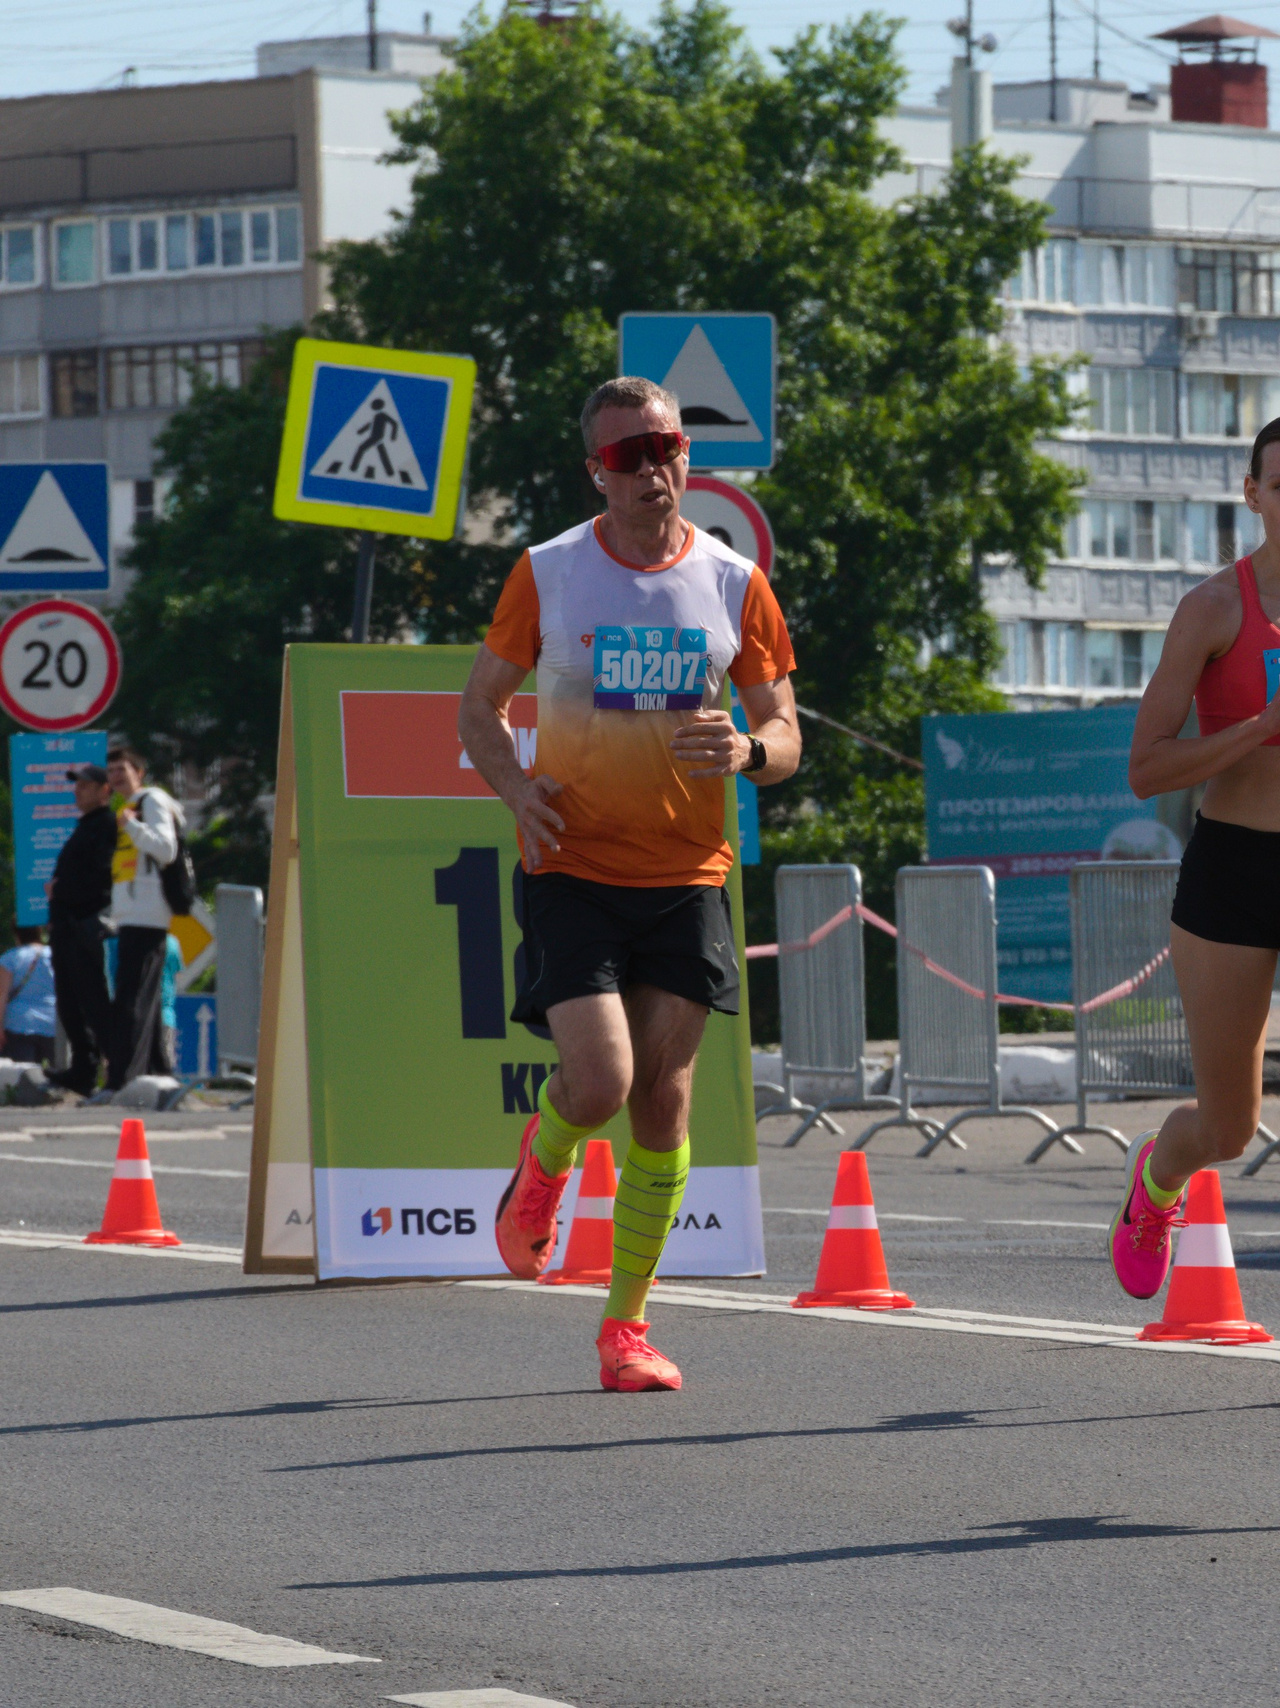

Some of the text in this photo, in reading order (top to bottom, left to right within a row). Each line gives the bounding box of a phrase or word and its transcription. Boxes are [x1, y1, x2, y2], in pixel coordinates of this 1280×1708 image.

[22, 641, 87, 689] 20
[601, 650, 700, 691] 50207
[401, 1207, 477, 1236] ПСБ
